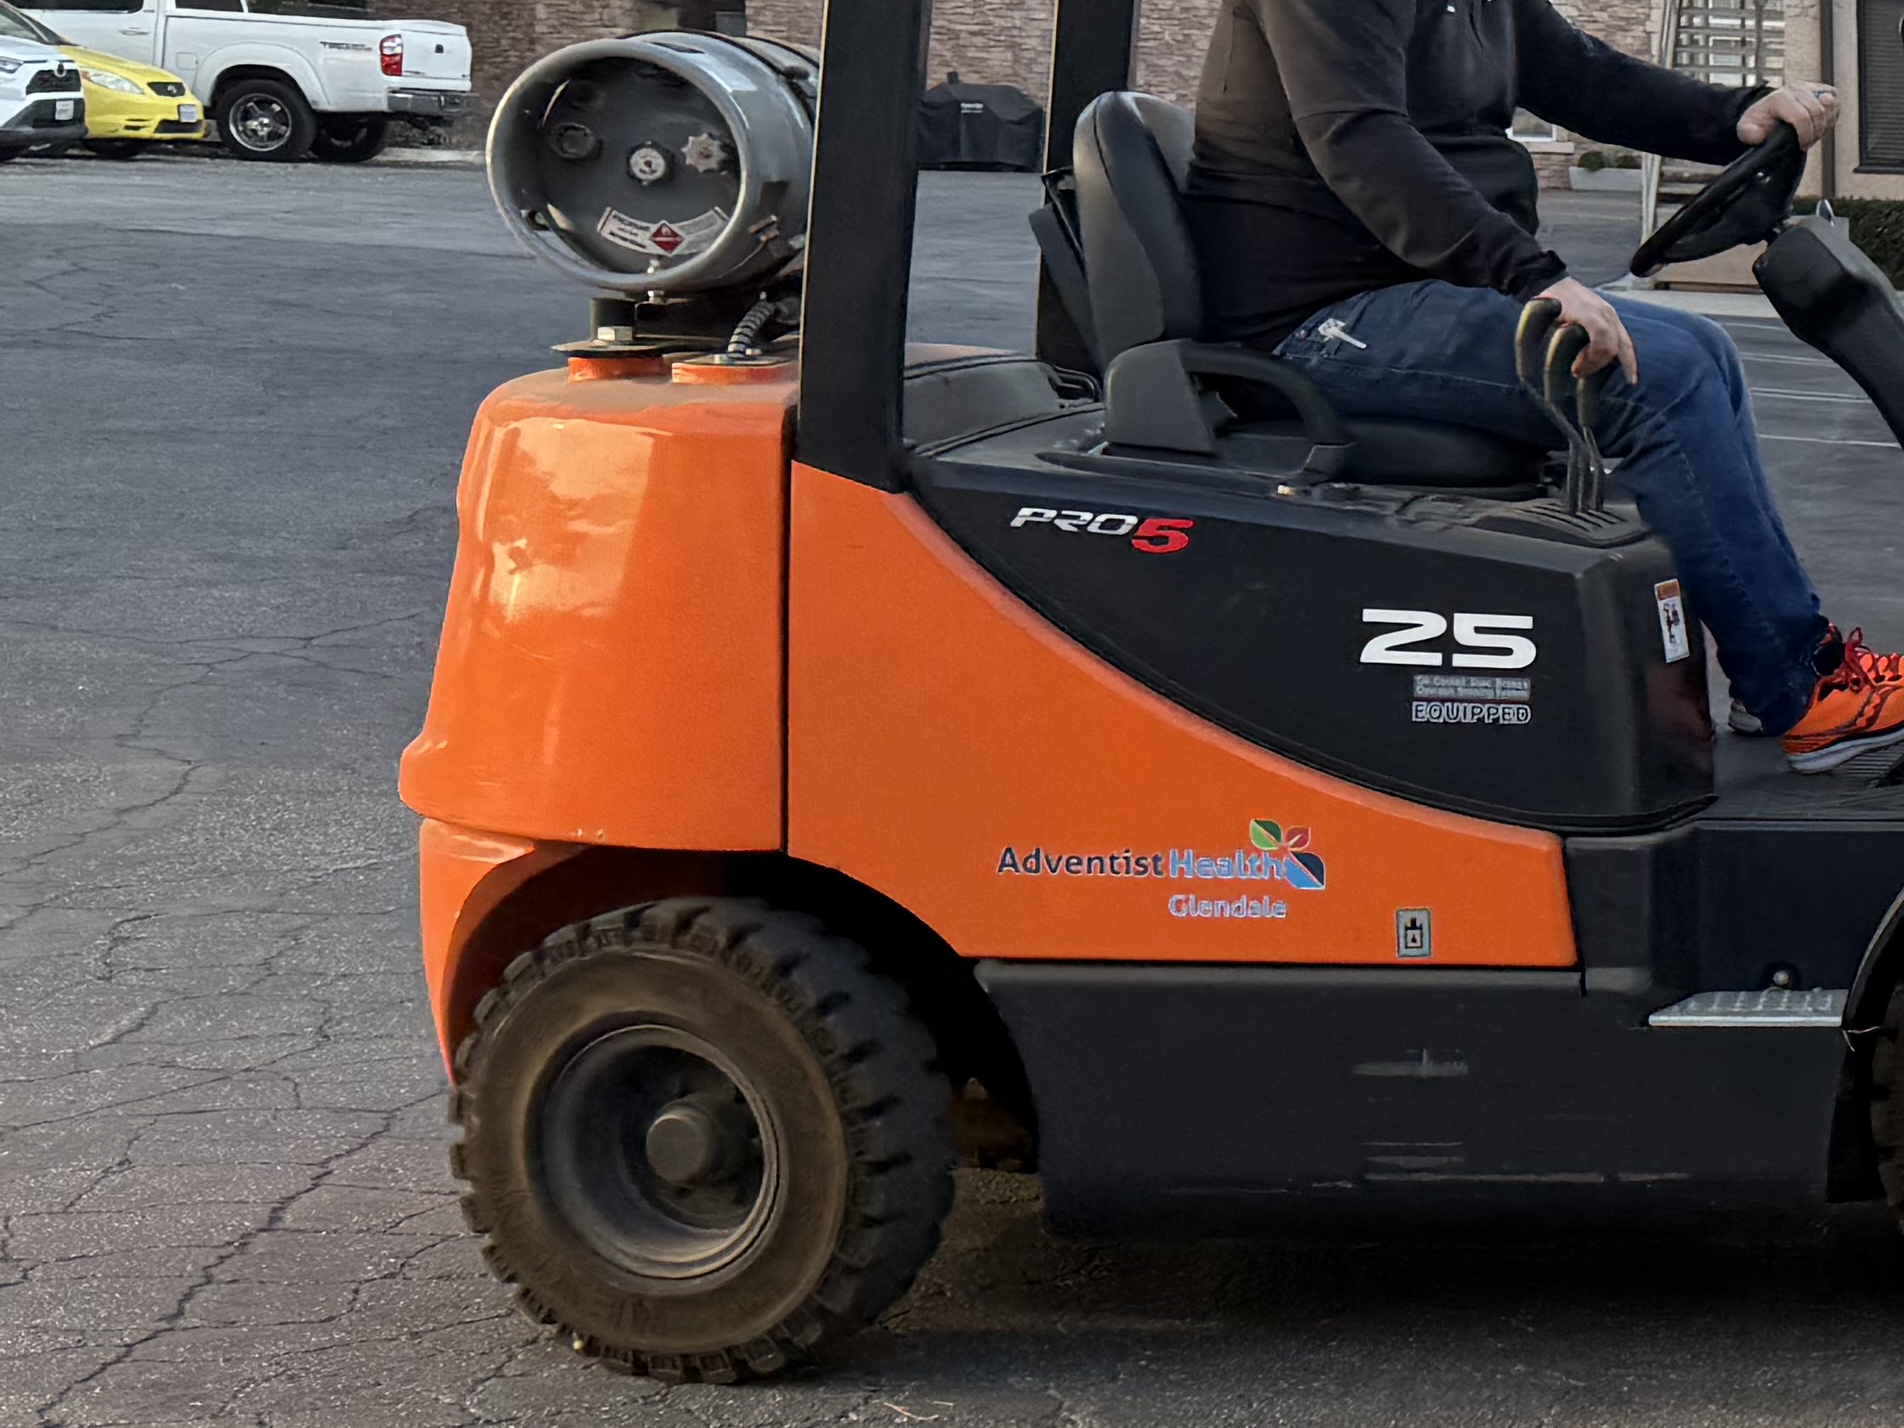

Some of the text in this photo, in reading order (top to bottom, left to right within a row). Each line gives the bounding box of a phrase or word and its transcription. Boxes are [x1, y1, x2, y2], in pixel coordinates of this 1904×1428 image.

[1360, 608, 1537, 669] 25
[1411, 701, 1532, 724] EQUIPPED
[998, 846, 1284, 879] Adventist Health
[1167, 894, 1288, 919] Glendale
